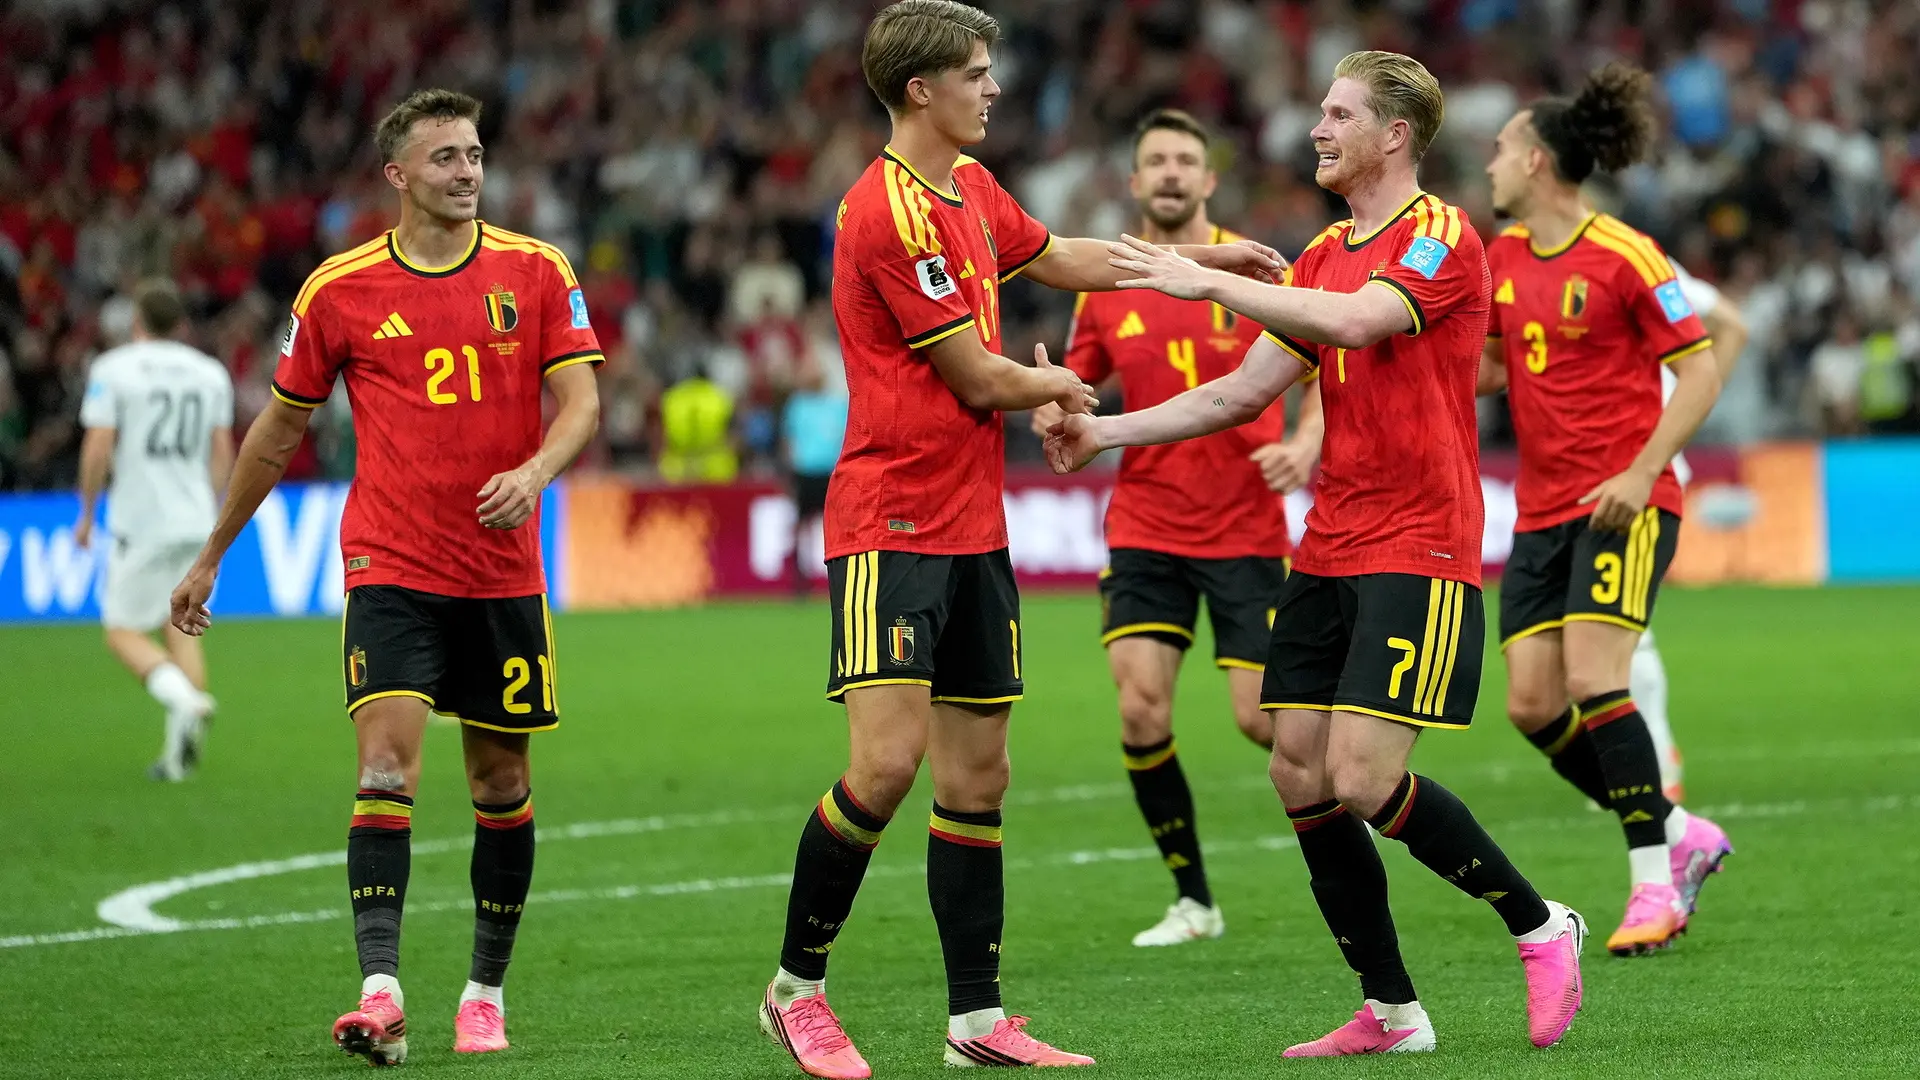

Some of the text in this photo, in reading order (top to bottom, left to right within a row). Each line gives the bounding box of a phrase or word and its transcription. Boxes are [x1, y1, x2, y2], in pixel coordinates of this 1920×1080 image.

[1167, 337, 1198, 389] 4
[1523, 321, 1547, 374] 3
[424, 344, 482, 405] 21
[145, 387, 202, 460] 20
[1590, 552, 1622, 604] 3
[503, 654, 553, 714] 21
[1387, 637, 1416, 699] 7
[352, 886, 396, 899] RBFA
[481, 900, 524, 914] RBFA
[807, 915, 846, 931] RB
